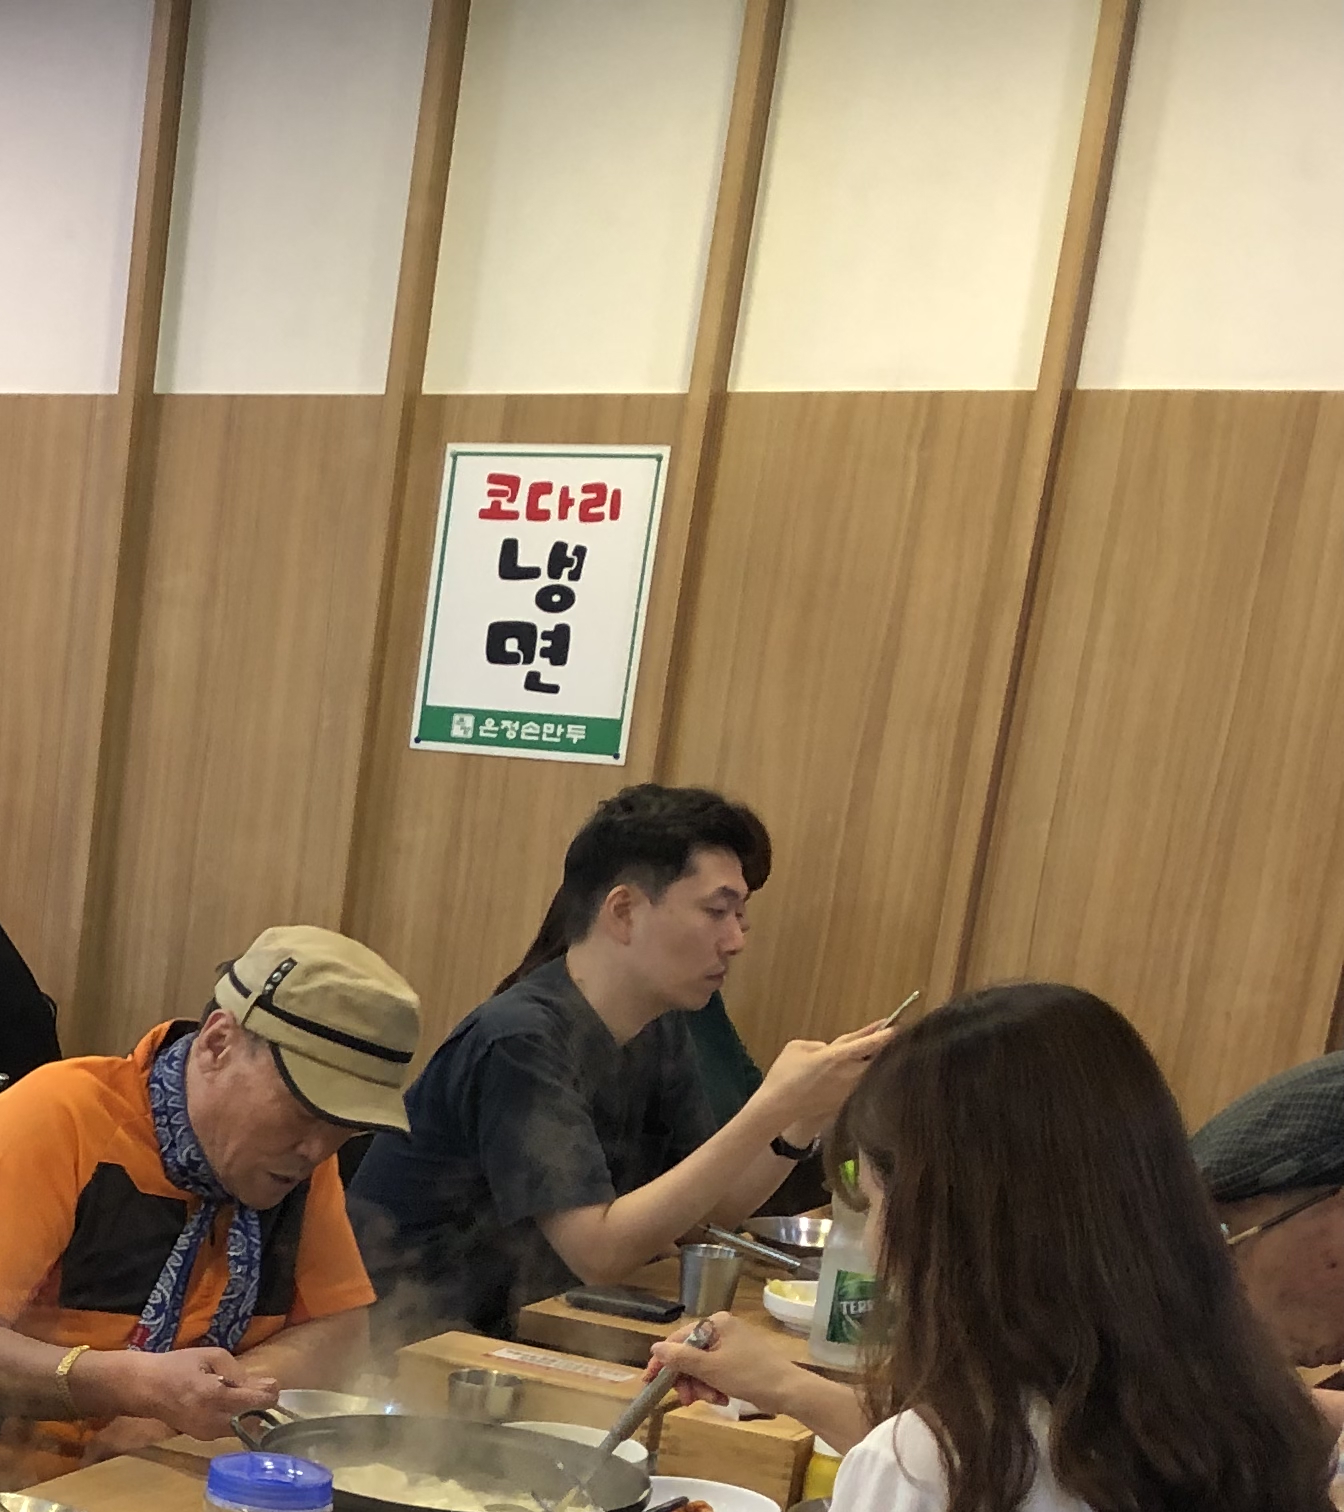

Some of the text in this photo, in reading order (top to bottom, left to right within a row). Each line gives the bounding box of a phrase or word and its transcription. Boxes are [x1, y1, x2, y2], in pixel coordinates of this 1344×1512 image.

[478, 471, 622, 523] 코다리
[478, 717, 587, 745] 은정손만두
[840, 1300, 874, 1315] TERR
